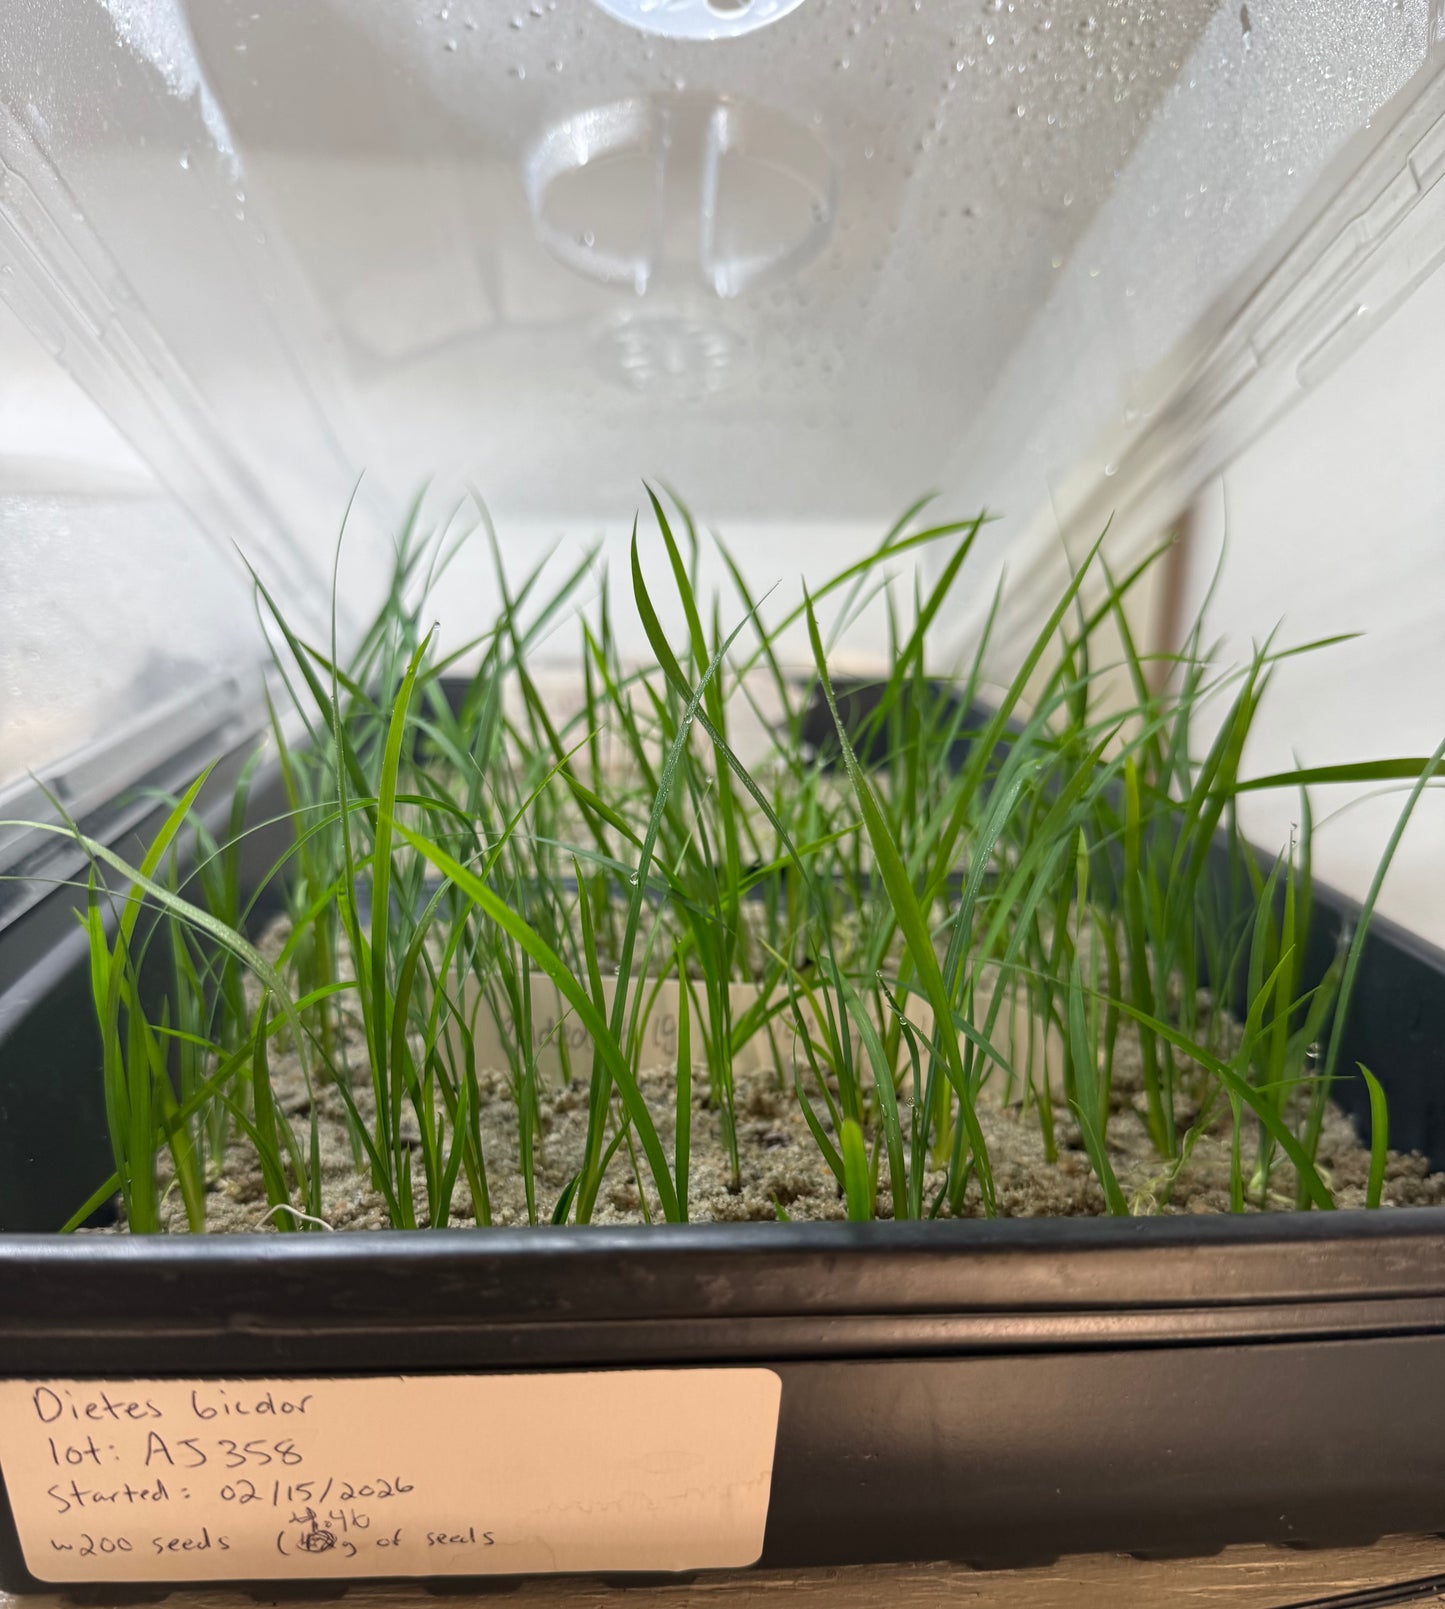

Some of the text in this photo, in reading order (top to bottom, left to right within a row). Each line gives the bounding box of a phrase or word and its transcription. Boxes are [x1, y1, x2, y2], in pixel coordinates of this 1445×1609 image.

[33, 1386, 162, 1423] Dietes
[48, 1436, 119, 1465] lot:
[220, 1477, 415, 1506] 02/15/2026
[152, 1527, 231, 1554] seeds
[376, 1528, 402, 1547] of
[426, 1527, 495, 1547] seeds
